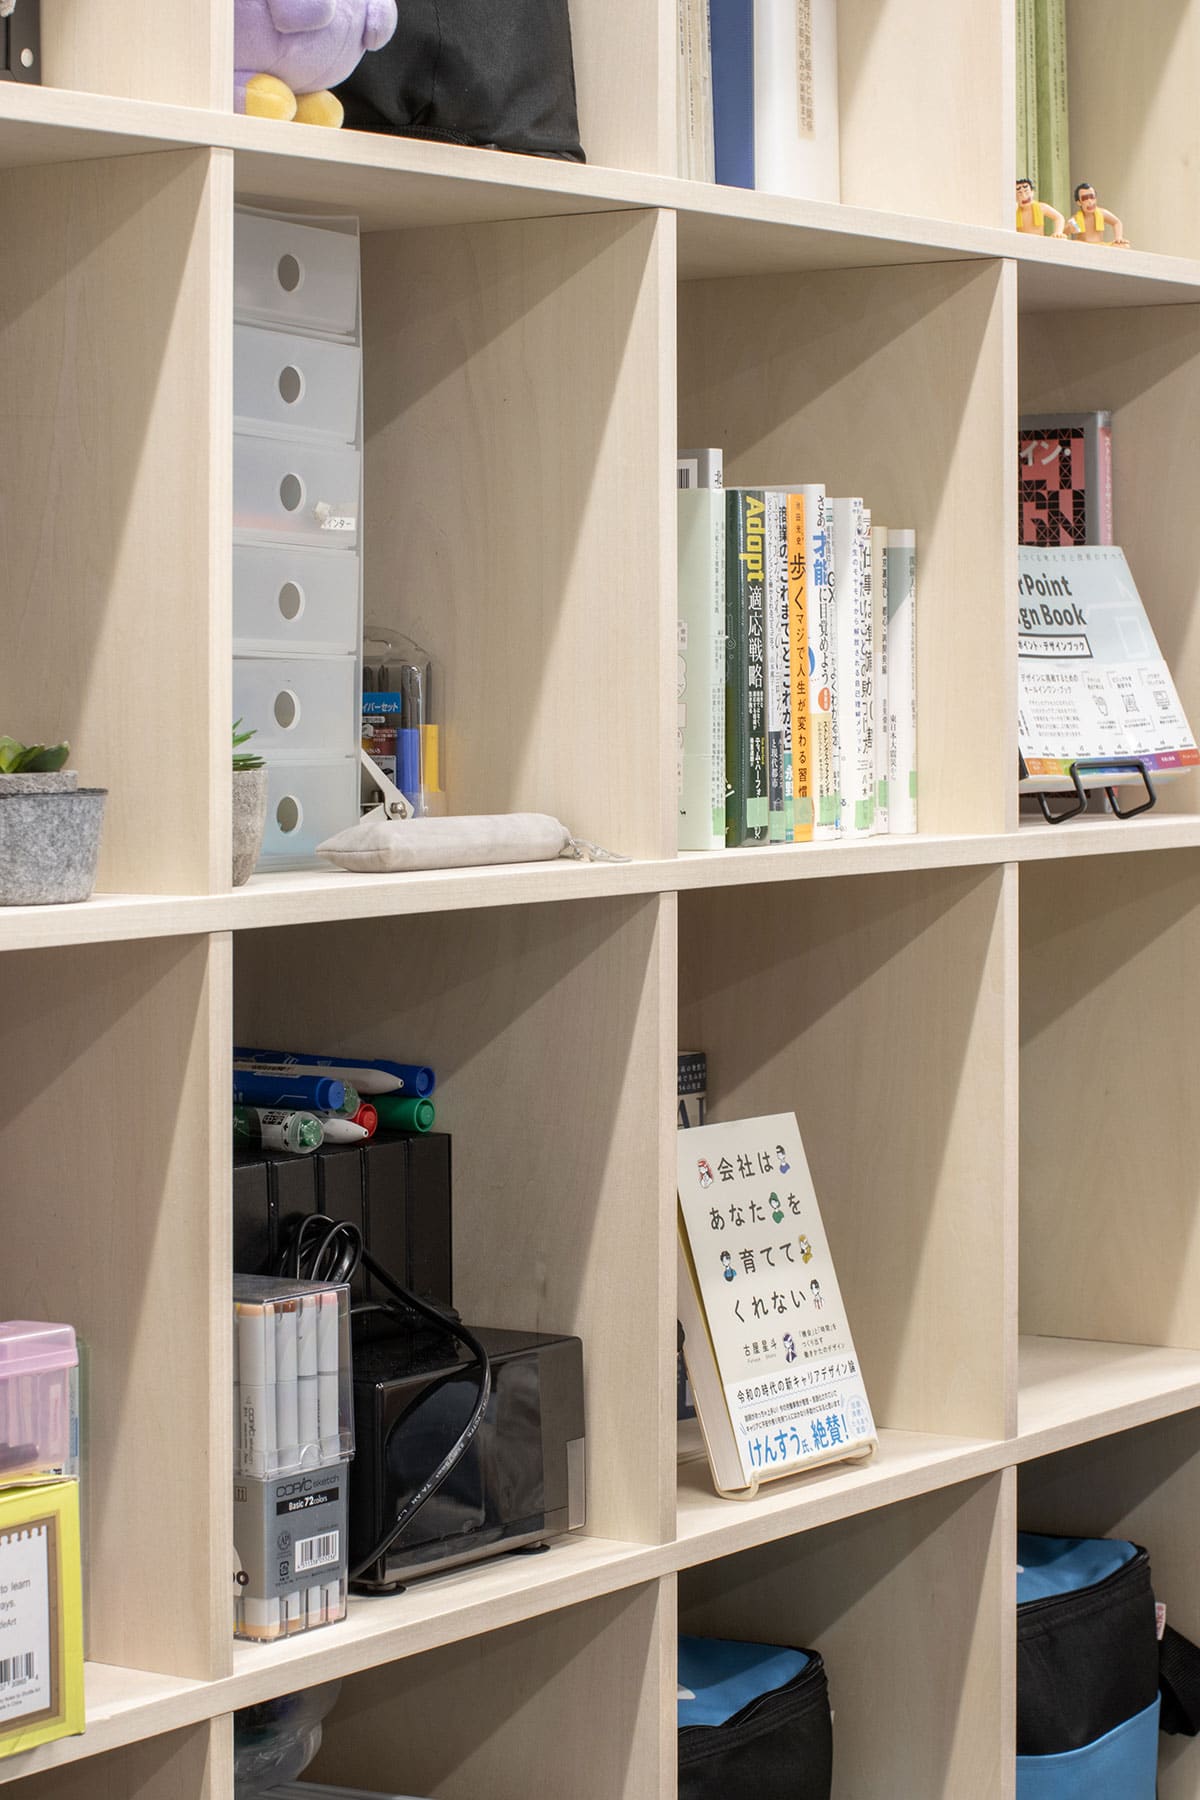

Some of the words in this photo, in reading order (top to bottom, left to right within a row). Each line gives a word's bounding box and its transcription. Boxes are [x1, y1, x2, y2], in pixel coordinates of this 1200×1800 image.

[739, 495, 765, 583] Adapt
[748, 585, 764, 688] 適応戦略
[717, 1151, 774, 1182] 会社は
[709, 1200, 766, 1230] あなた
[787, 1192, 801, 1215] を
[738, 1242, 795, 1274] 育てて
[734, 1289, 807, 1323] くれない
[736, 1359, 857, 1403] 令和の時代の新キャリアデザイン論
[288, 1500, 304, 1512] Basic
[11, 1579, 31, 1592] learn
